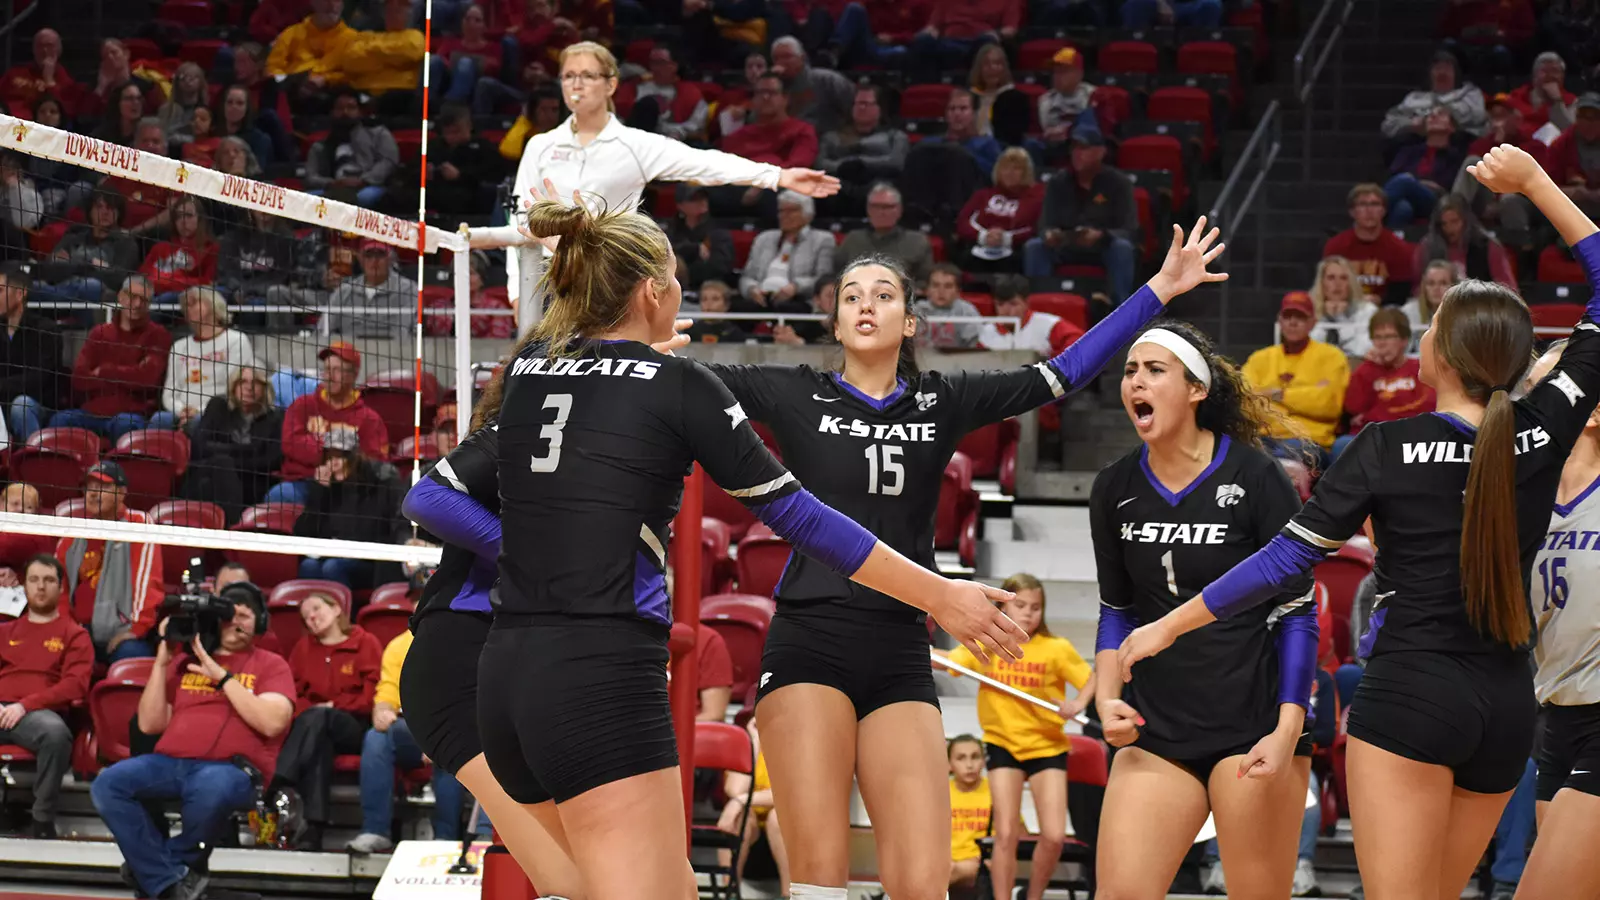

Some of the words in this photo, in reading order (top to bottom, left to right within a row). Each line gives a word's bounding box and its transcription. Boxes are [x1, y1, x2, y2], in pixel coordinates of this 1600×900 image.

[65, 132, 99, 161] IOWA
[100, 141, 141, 173] STATE
[220, 173, 250, 201] IOWA
[250, 181, 287, 210] STATE
[354, 204, 381, 236] IOWA
[511, 356, 661, 380] WILDCATS
[530, 393, 573, 473] 3
[818, 414, 936, 442] K-STATE
[865, 443, 905, 496] 15
[1120, 522, 1229, 545] K-STATE
[1161, 550, 1179, 597] 1
[1538, 557, 1569, 612] 16
